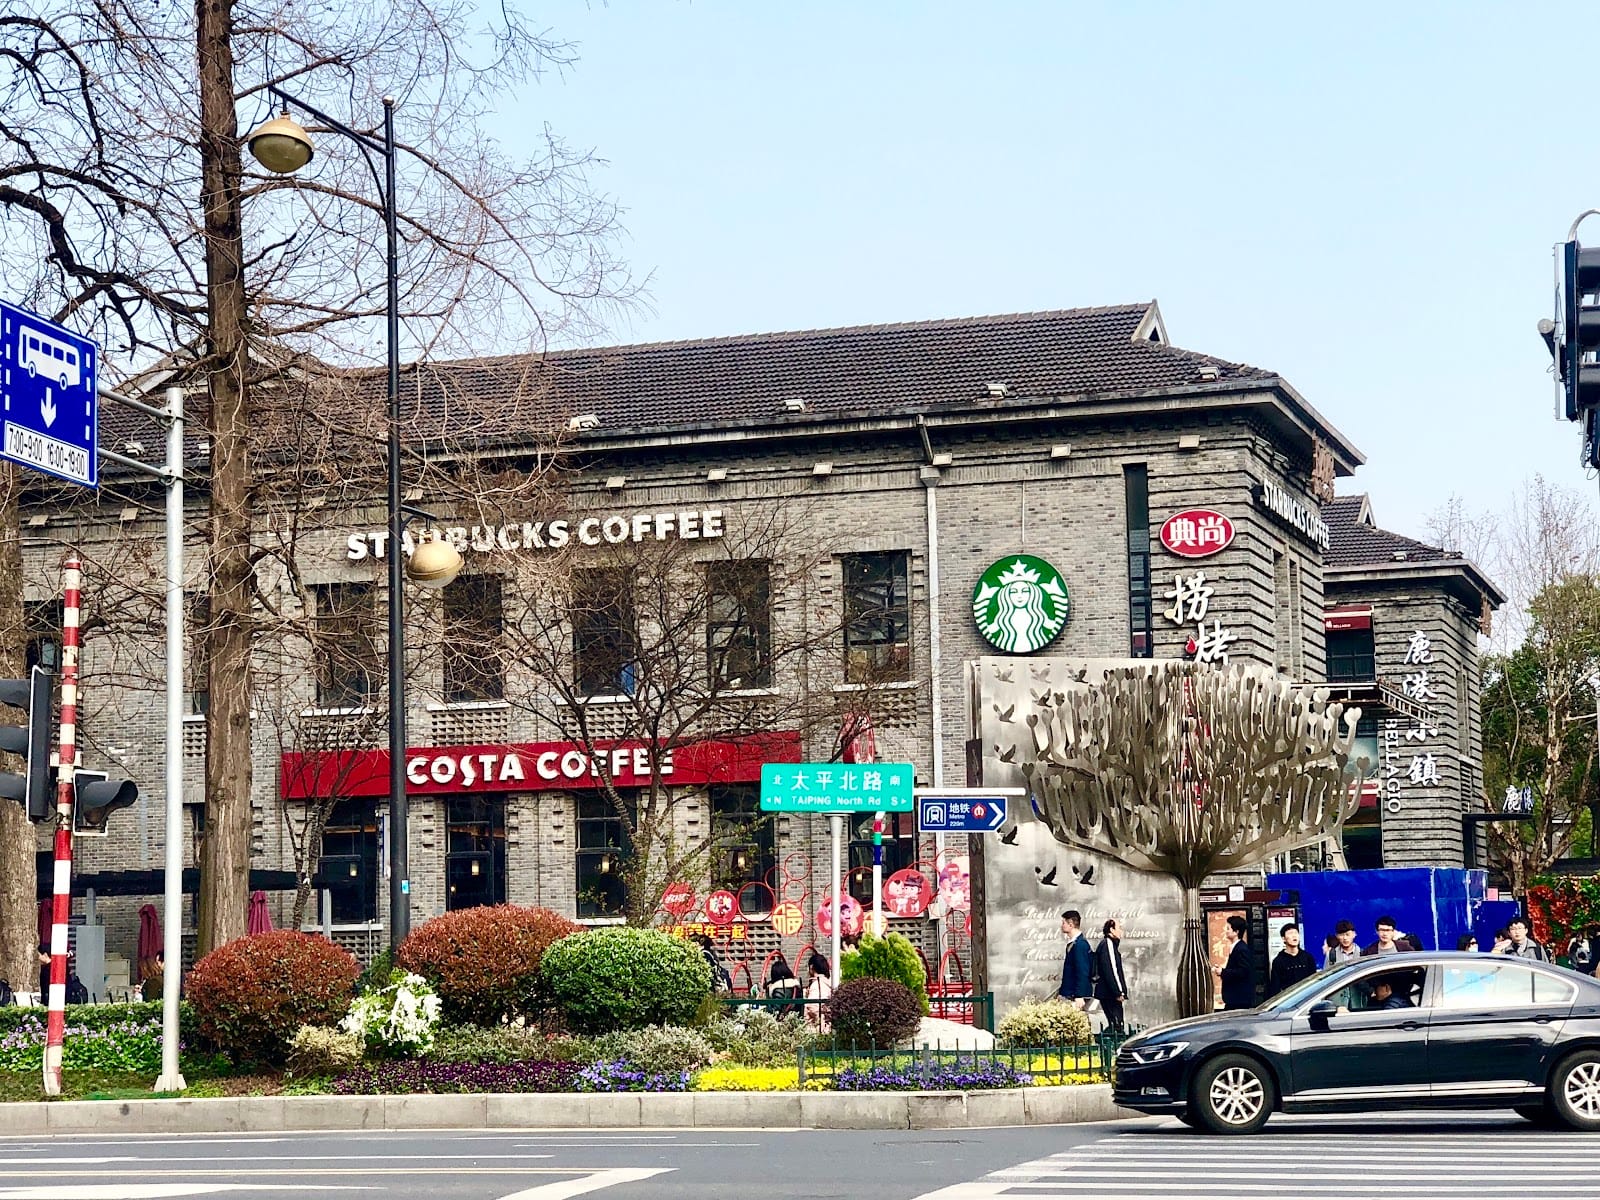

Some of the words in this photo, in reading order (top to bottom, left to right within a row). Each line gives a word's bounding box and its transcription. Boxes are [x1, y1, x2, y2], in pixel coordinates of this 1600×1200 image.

[9, 427, 43, 462] 7:00-9:00
[47, 442, 86, 477] 16:00-19:00
[1264, 478, 1306, 533] STARBUCKS
[578, 509, 724, 546] COFFEE
[1167, 515, 1226, 548] 典尚
[406, 753, 525, 787] COSTA
[772, 774, 783, 786] 北
[790, 770, 883, 792] 太平北路
[889, 774, 901, 787] 南
[1385, 718, 1401, 813] BELLAGIO
[774, 795, 782, 805] N
[791, 795, 832, 806] TAIPING
[836, 795, 863, 806] North
[867, 795, 881, 806] Rd
[890, 795, 899, 806] S
[949, 802, 971, 814] 地铁
[772, 903, 804, 935] 福
